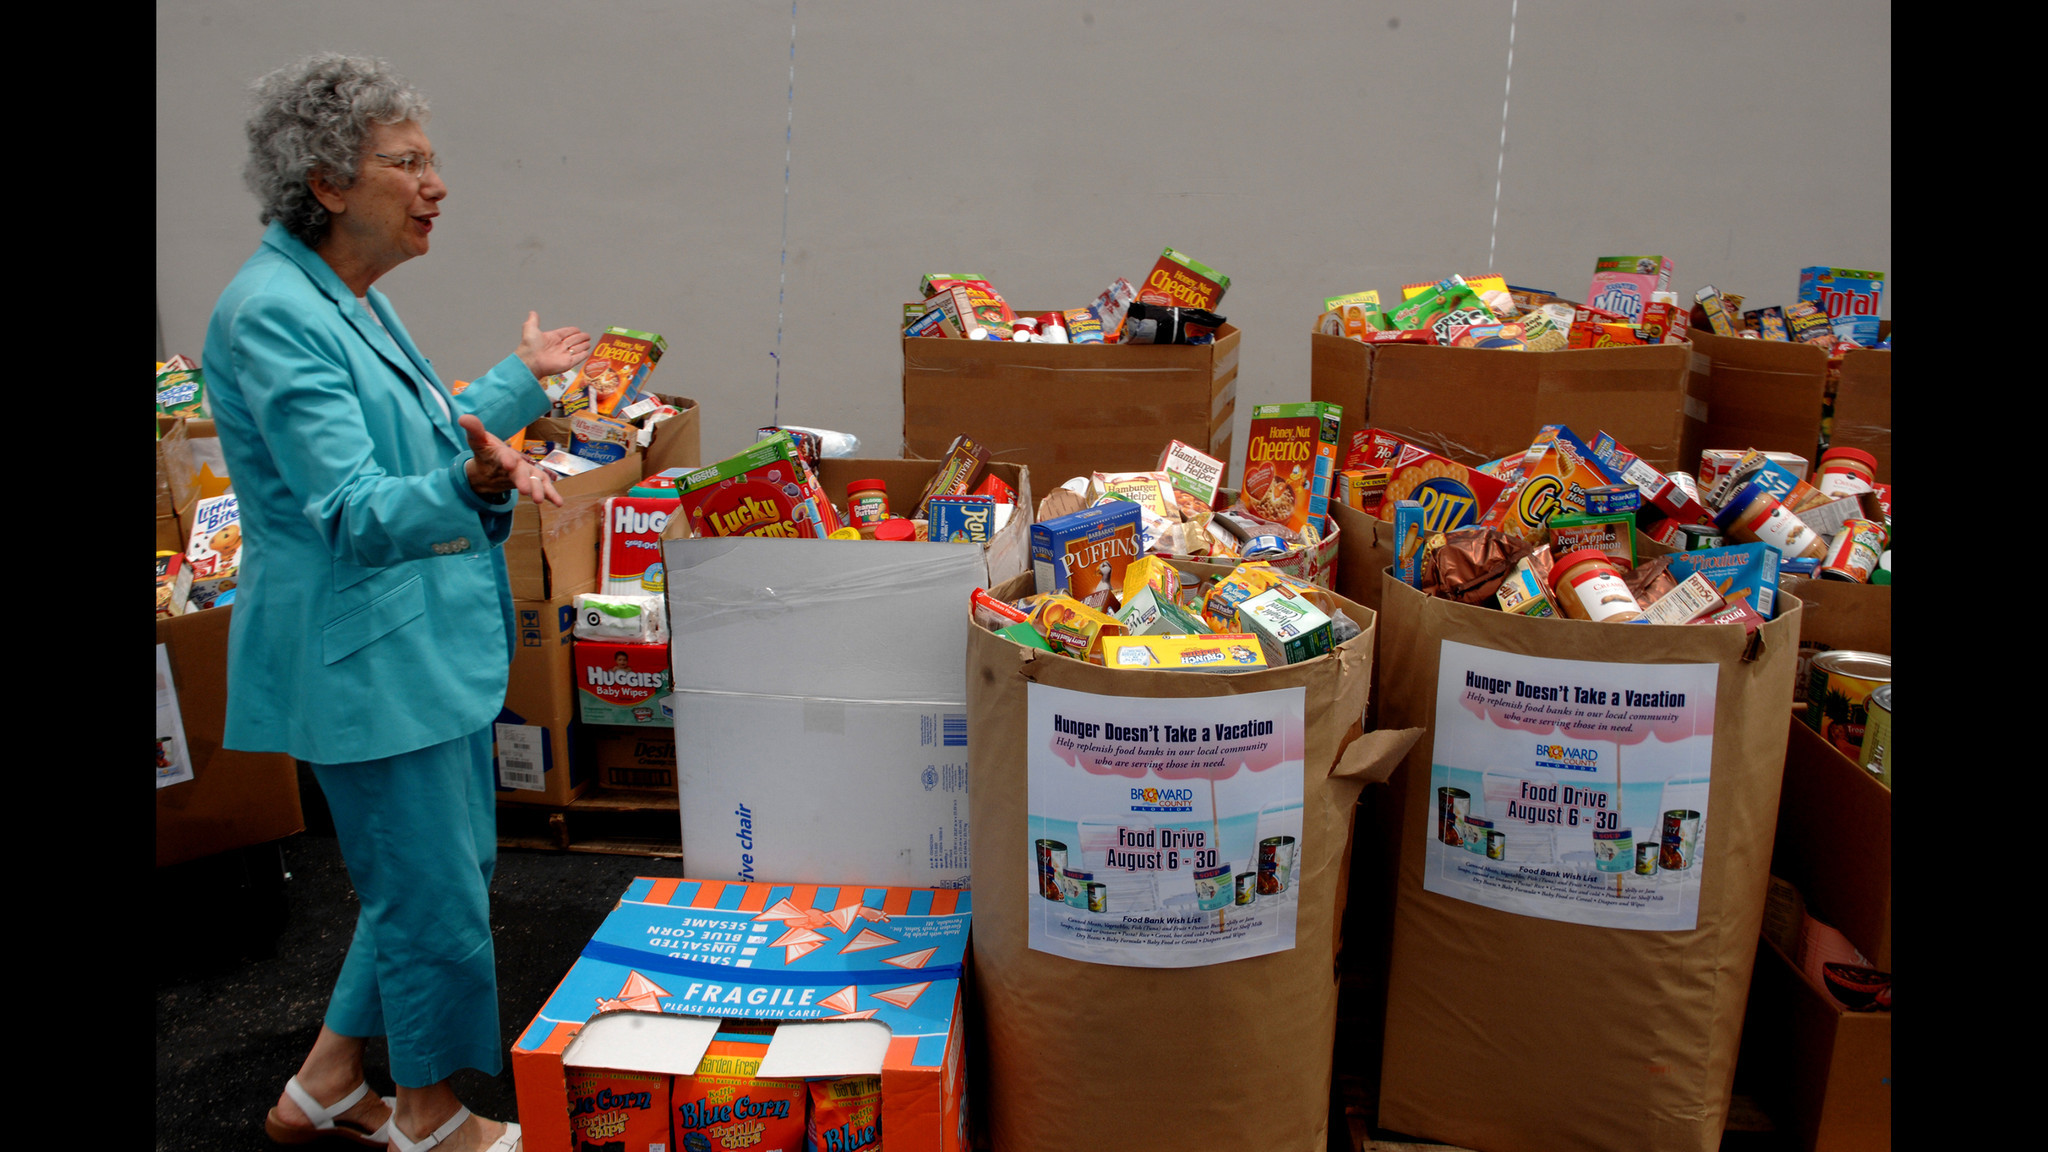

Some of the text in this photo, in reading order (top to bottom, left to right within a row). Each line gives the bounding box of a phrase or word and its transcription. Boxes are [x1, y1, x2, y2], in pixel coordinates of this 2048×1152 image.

[1150, 269, 1209, 309] Cheerios
[1174, 270, 1212, 296] Honey Nut
[1815, 286, 1880, 319] Total
[593, 342, 643, 365] Cheerios
[613, 339, 646, 351] Honey Nut
[1269, 425, 1311, 440] Honey Nut
[577, 448, 617, 462] Blueberry
[1249, 436, 1311, 462] Cheerios
[1170, 446, 1220, 475] Hamburger
[950, 458, 973, 488] HEALTHY
[1184, 463, 1215, 483] Helper
[1107, 483, 1157, 493] Hamburger
[1126, 493, 1157, 503] Helper
[198, 498, 239, 525] Little
[709, 496, 781, 537] Lucky
[853, 503, 879, 513] Peanut
[855, 509, 879, 518] Butter
[1416, 486, 1474, 533] RITZ
[1557, 531, 1616, 546] Real Apples
[1561, 542, 1622, 554] & Cinnamon
[1058, 533, 1141, 579] PUFFINS
[1262, 608, 1291, 627] Weight
[1266, 602, 1298, 619] Control
[1050, 631, 1087, 647] Cherry Mixed Fruit
[1180, 652, 1226, 665] CRUNCH
[587, 665, 663, 688] HUGGIES
[596, 686, 648, 698] Baby Wipes
[1466, 670, 1686, 708] Hunger Doesn't Take a Vacation
[1466, 691, 1486, 704] Help
[1487, 698, 1523, 710] replenish
[1522, 702, 1544, 713] food
[1546, 706, 1572, 716] banks
[1574, 708, 1584, 717] in
[1605, 710, 1628, 720] local
[1628, 713, 1680, 724] community
[1054, 714, 1273, 743] Hunger Doesn't Take a Vacation
[1503, 712, 1521, 722] who
[1539, 718, 1572, 730] serving
[1573, 720, 1596, 730] those
[1597, 722, 1608, 730] in
[1610, 723, 1633, 732] need.
[1056, 736, 1075, 749] Help
[1076, 742, 1114, 754] replenish
[1113, 745, 1136, 757] food
[1137, 747, 1164, 756] banks
[1166, 747, 1176, 756] in
[1197, 745, 1220, 756] local
[1220, 741, 1269, 754] community
[1536, 744, 1598, 761] BROWARD
[1095, 757, 1226, 772] who are serving those in need.
[1537, 762, 1596, 772] FLORIDA
[1563, 757, 1598, 767] COUNTY
[1130, 787, 1193, 803] BROWARD
[1521, 781, 1608, 808] Food Drive
[1507, 800, 1563, 824] August
[1568, 808, 1580, 826] 6
[1596, 811, 1618, 830] 30
[735, 803, 753, 851] chair
[1119, 828, 1205, 849] Food Drive
[1107, 848, 1162, 871] August
[1168, 852, 1179, 869] 6
[1195, 850, 1217, 868] 30
[1518, 865, 1598, 883] Food Bank Wish List
[682, 918, 748, 931] SESAME
[1122, 915, 1144, 923] Food
[646, 925, 743, 943] BLUE CORN
[649, 937, 738, 954] UNSALTED
[683, 982, 816, 1006] FRAGILE
[663, 1002, 822, 1017] PLEASE HANDLE WITH CARE!
[700, 1056, 760, 1077] Garden Fresh
[707, 1086, 736, 1098] Kettle
[748, 1080, 787, 1089] CHOLESTEROL
[833, 1079, 864, 1098] Garden
[597, 1088, 652, 1111] Corn
[573, 1110, 629, 1129] Tortilla
[680, 1095, 791, 1130] Blue Corn
[849, 1105, 874, 1122] Kettle
[586, 1121, 627, 1139] Chips
[709, 1119, 766, 1139] Tortilla
[823, 1122, 876, 1152] Blue
[720, 1133, 762, 1150] Chips
